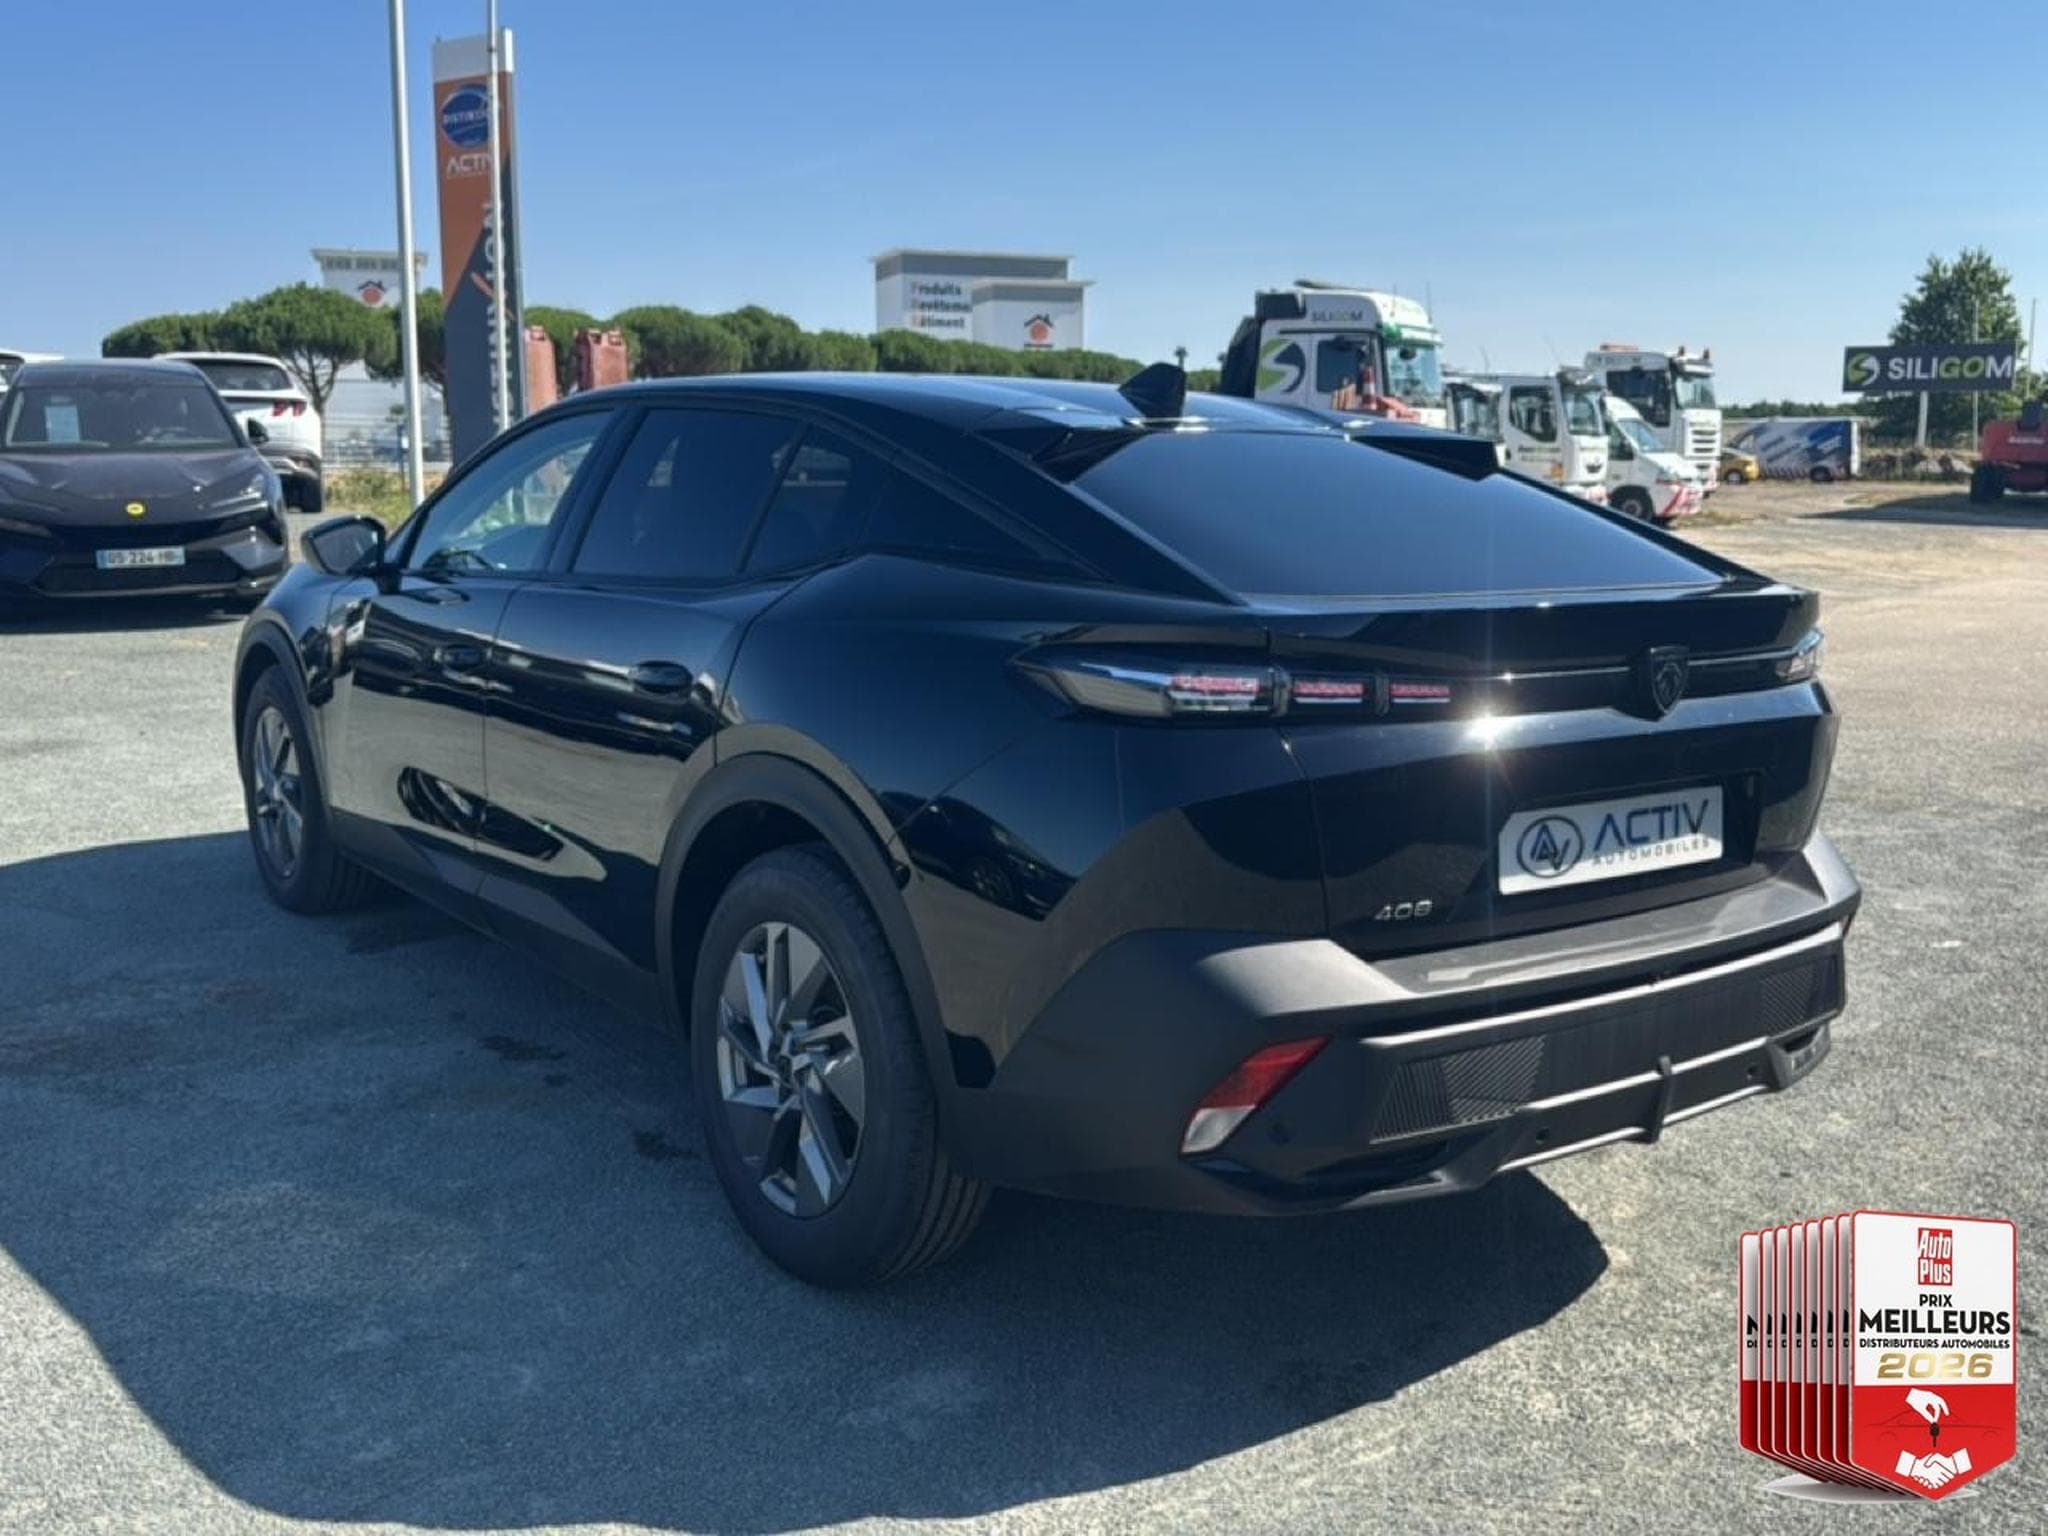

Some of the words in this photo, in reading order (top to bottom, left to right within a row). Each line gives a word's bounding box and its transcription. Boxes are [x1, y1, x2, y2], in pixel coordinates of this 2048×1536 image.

[1887, 355, 2013, 380] SILIGOM
[1593, 799, 1709, 851] ACTIV
[1592, 838, 1709, 866] AUTOMOBILES
[1374, 900, 1433, 921] 408
